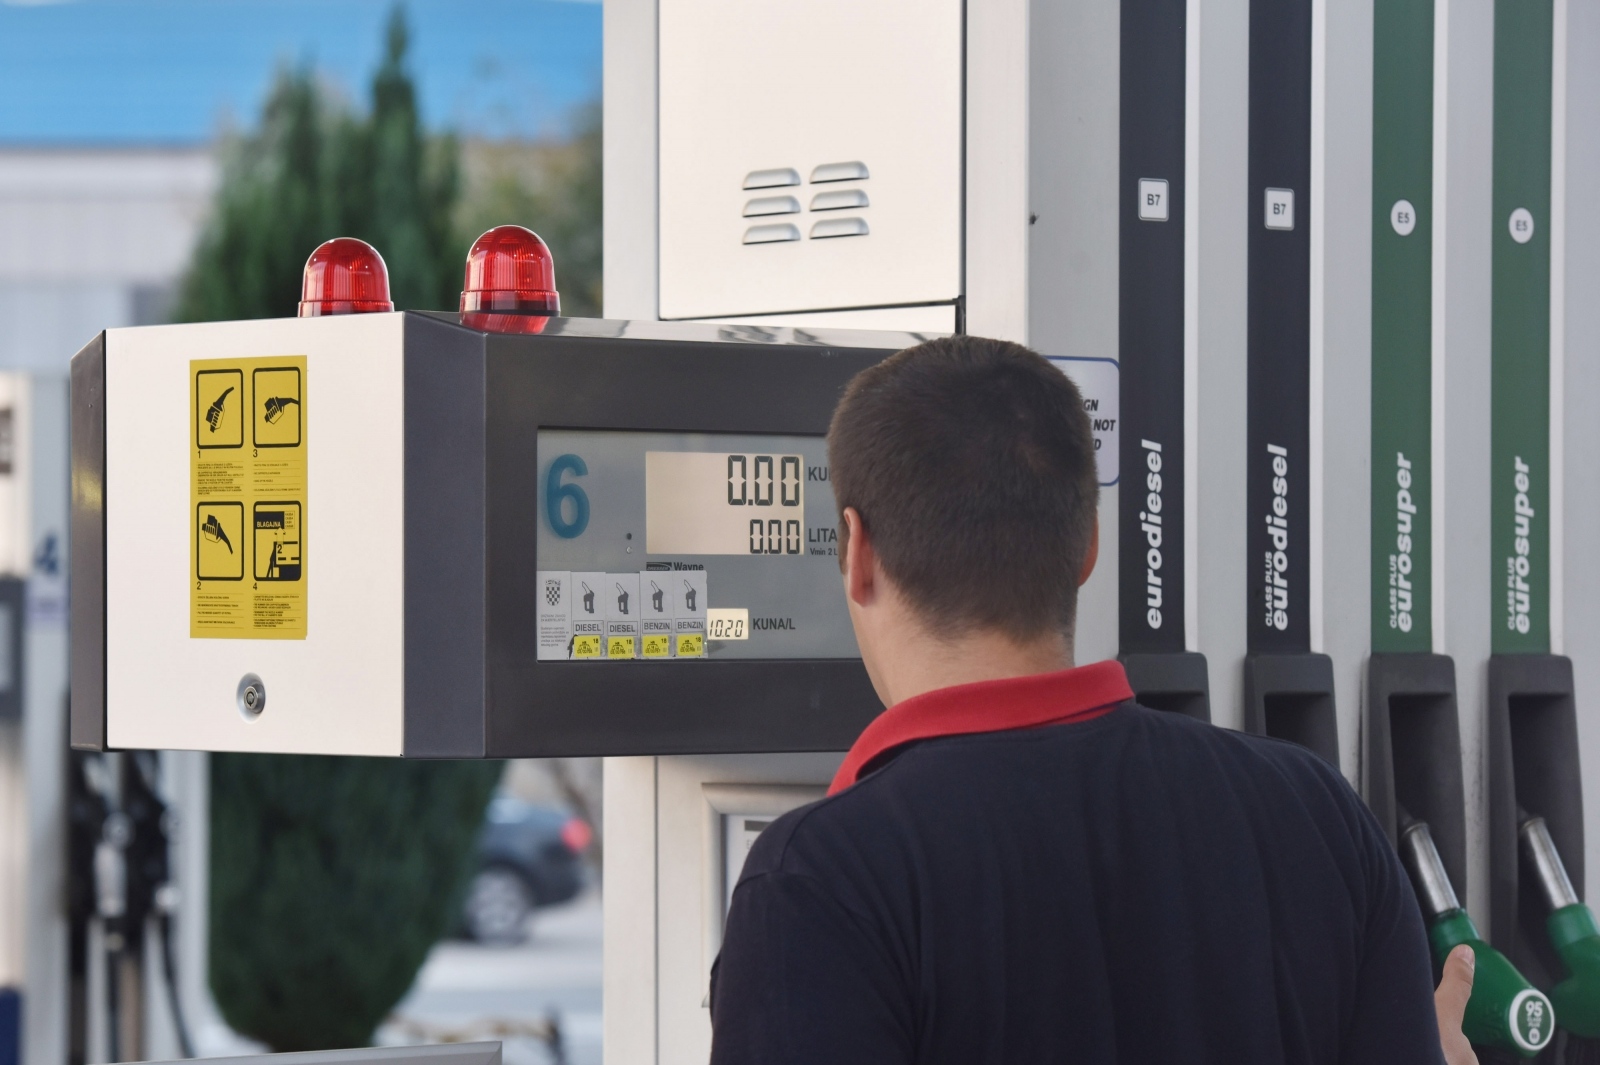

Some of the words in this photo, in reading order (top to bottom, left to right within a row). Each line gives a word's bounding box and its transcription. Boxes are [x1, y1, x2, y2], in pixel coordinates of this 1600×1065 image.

[1147, 193, 1161, 206] B7
[1273, 203, 1286, 215] B7
[1397, 212, 1410, 224] E5
[1515, 220, 1528, 231] E5
[1081, 399, 1099, 411] GN
[1093, 419, 1116, 431] NOT
[197, 450, 201, 459] 1
[252, 449, 258, 458] 3
[808, 466, 832, 482] KU
[727, 455, 800, 506] 0.00
[547, 453, 591, 540] 6
[749, 519, 800, 554] 0.00
[1139, 439, 1163, 630] eurodiesel
[1265, 444, 1289, 631] eurodiesel
[1396, 452, 1417, 633] eurosuper
[1515, 455, 1535, 634] eurosuper
[277, 544, 283, 554] 2
[810, 547, 826, 556] Vmin
[828, 547, 833, 556] 2
[673, 561, 704, 571] Wayne
[1265, 551, 1273, 584] PLUS
[1389, 554, 1397, 587] PLUS
[196, 581, 202, 590] 2
[252, 582, 258, 590] 4
[1265, 585, 1273, 627] CLASS
[1389, 587, 1397, 629] CLASS
[575, 623, 602, 632] DIESEL
[609, 624, 636, 633] DIESEL
[643, 622, 670, 630] BENZIN
[677, 621, 704, 629] BENZIN
[709, 619, 744, 638] 10.20
[753, 618, 796, 630] KUNA/L
[1525, 1000, 1543, 1017] 95
